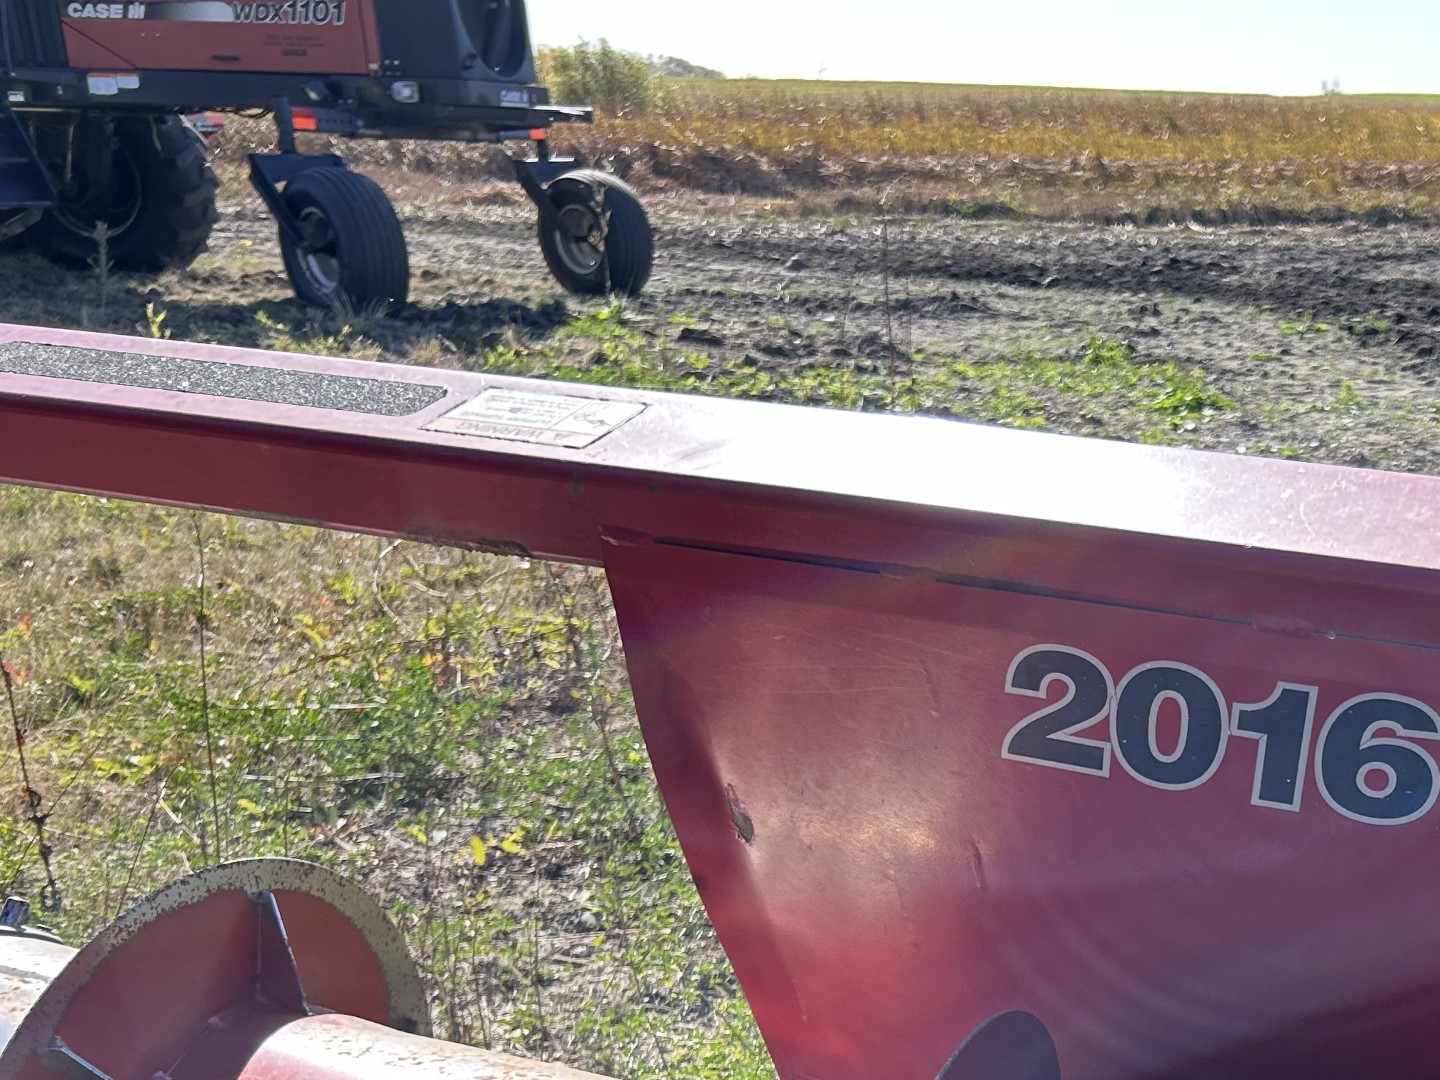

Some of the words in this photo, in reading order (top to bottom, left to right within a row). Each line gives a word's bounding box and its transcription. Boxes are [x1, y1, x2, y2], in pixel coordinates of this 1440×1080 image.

[67, 2, 123, 18] CASE
[231, 0, 346, 25] WDX1101
[455, 422, 544, 438] WARNING
